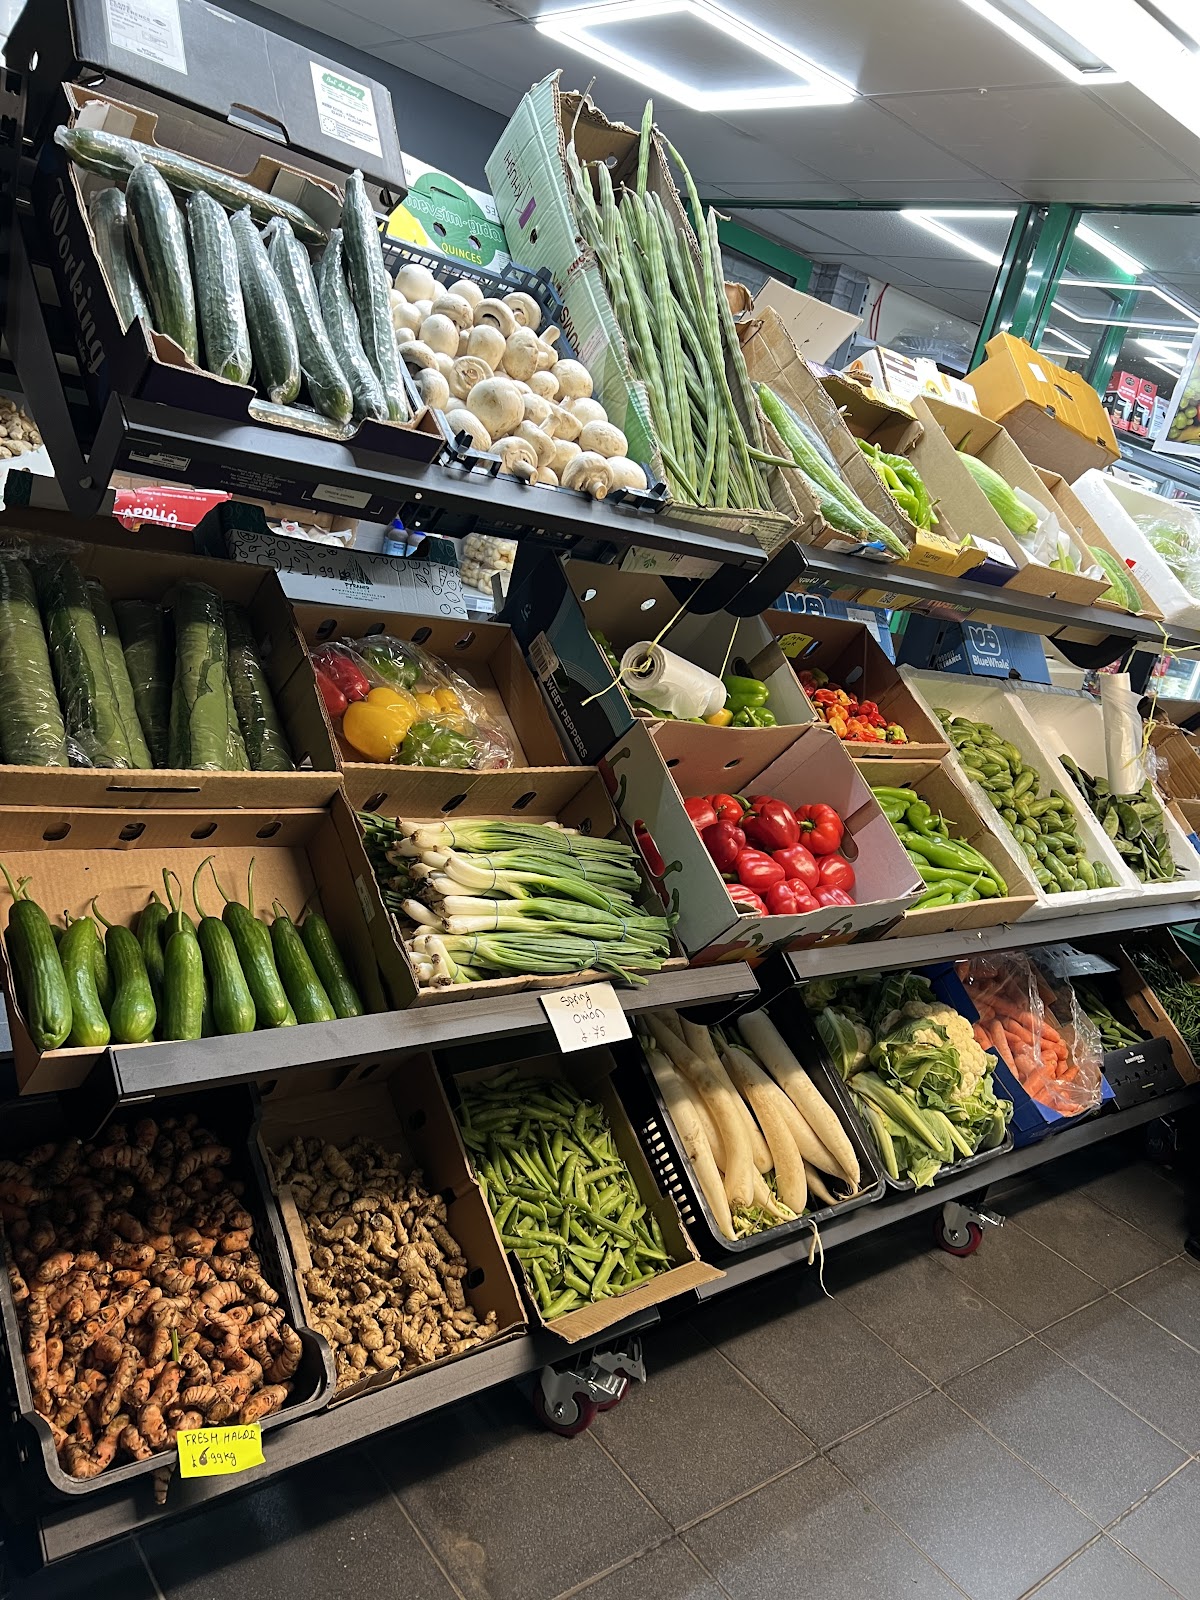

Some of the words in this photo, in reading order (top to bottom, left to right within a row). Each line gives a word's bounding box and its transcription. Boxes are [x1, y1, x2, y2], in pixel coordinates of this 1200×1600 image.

[503, 149, 523, 201] KHUSHI
[441, 242, 483, 265] QUINCES
[50, 176, 106, 377] Working
[123, 507, 178, 523] APOLLO
[923, 551, 942, 562] Turkey
[971, 654, 1010, 670] BlueWhale
[546, 677, 564, 709] WEET
[560, 708, 588, 758] PEPPERS
[560, 991, 593, 1009] Spring
[572, 1008, 606, 1024] Onion
[184, 1431, 219, 1446] FRESH
